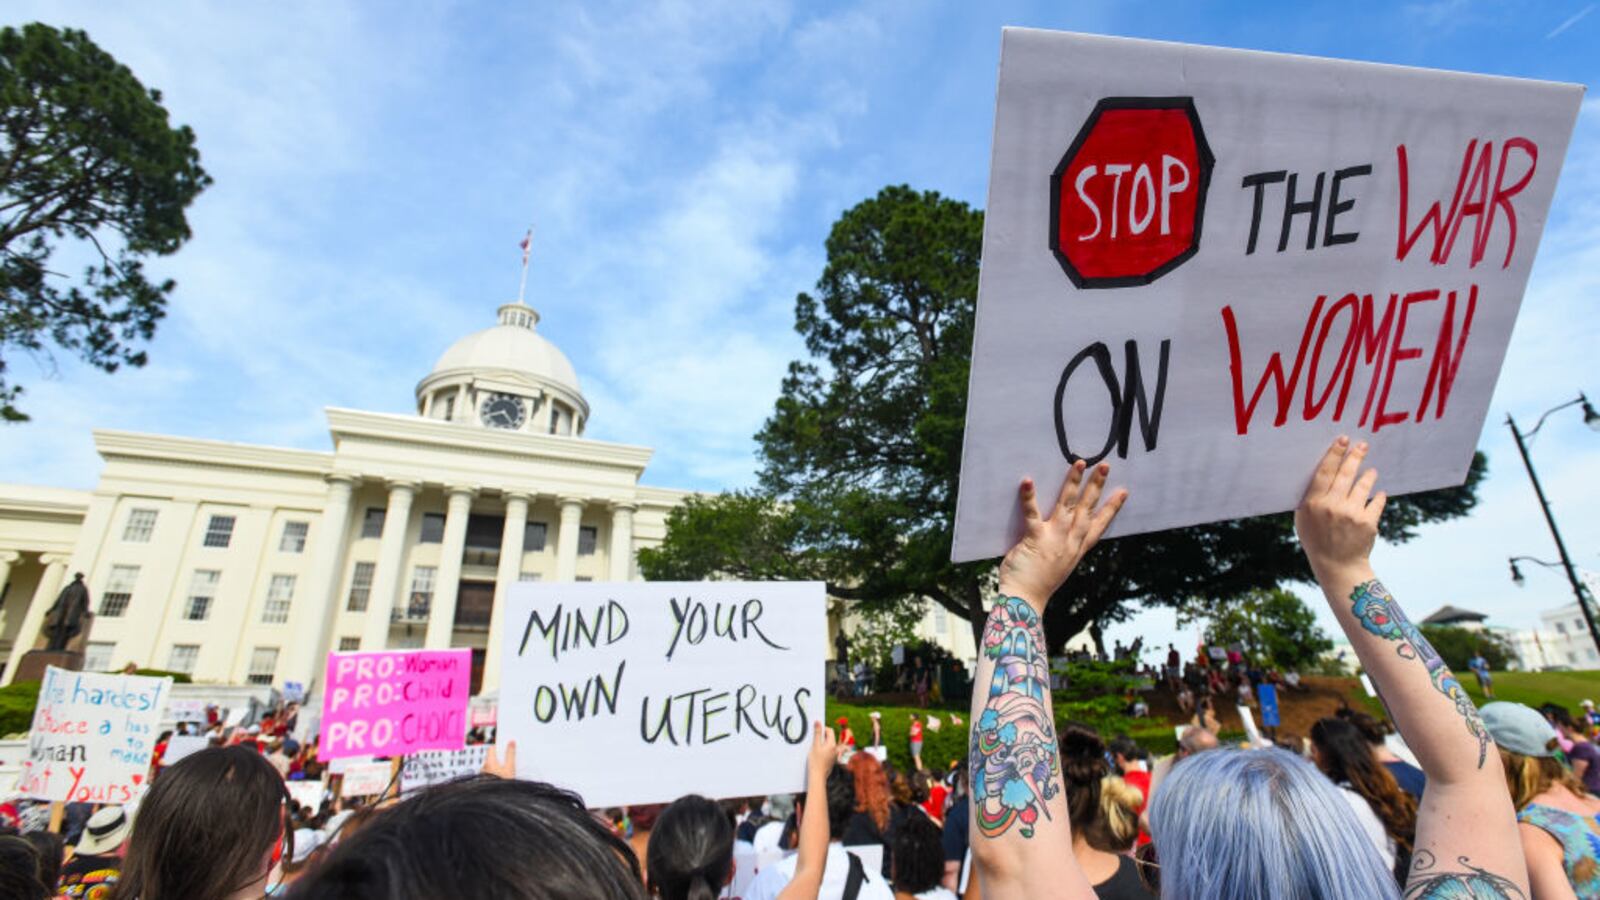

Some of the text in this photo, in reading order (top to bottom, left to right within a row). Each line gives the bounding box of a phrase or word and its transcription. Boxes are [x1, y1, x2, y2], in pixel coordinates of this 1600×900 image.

[1074, 136, 1539, 270] STOP THE WAR
[1053, 284, 1479, 468] ON WOMEN
[518, 596, 791, 662] MIND YOUR
[72, 676, 162, 711] hardest
[336, 655, 404, 684] PRO:
[330, 682, 402, 713] PRO:
[403, 679, 454, 702] Child
[534, 660, 811, 746] OWN UTERUS
[326, 717, 400, 753] PRO:
